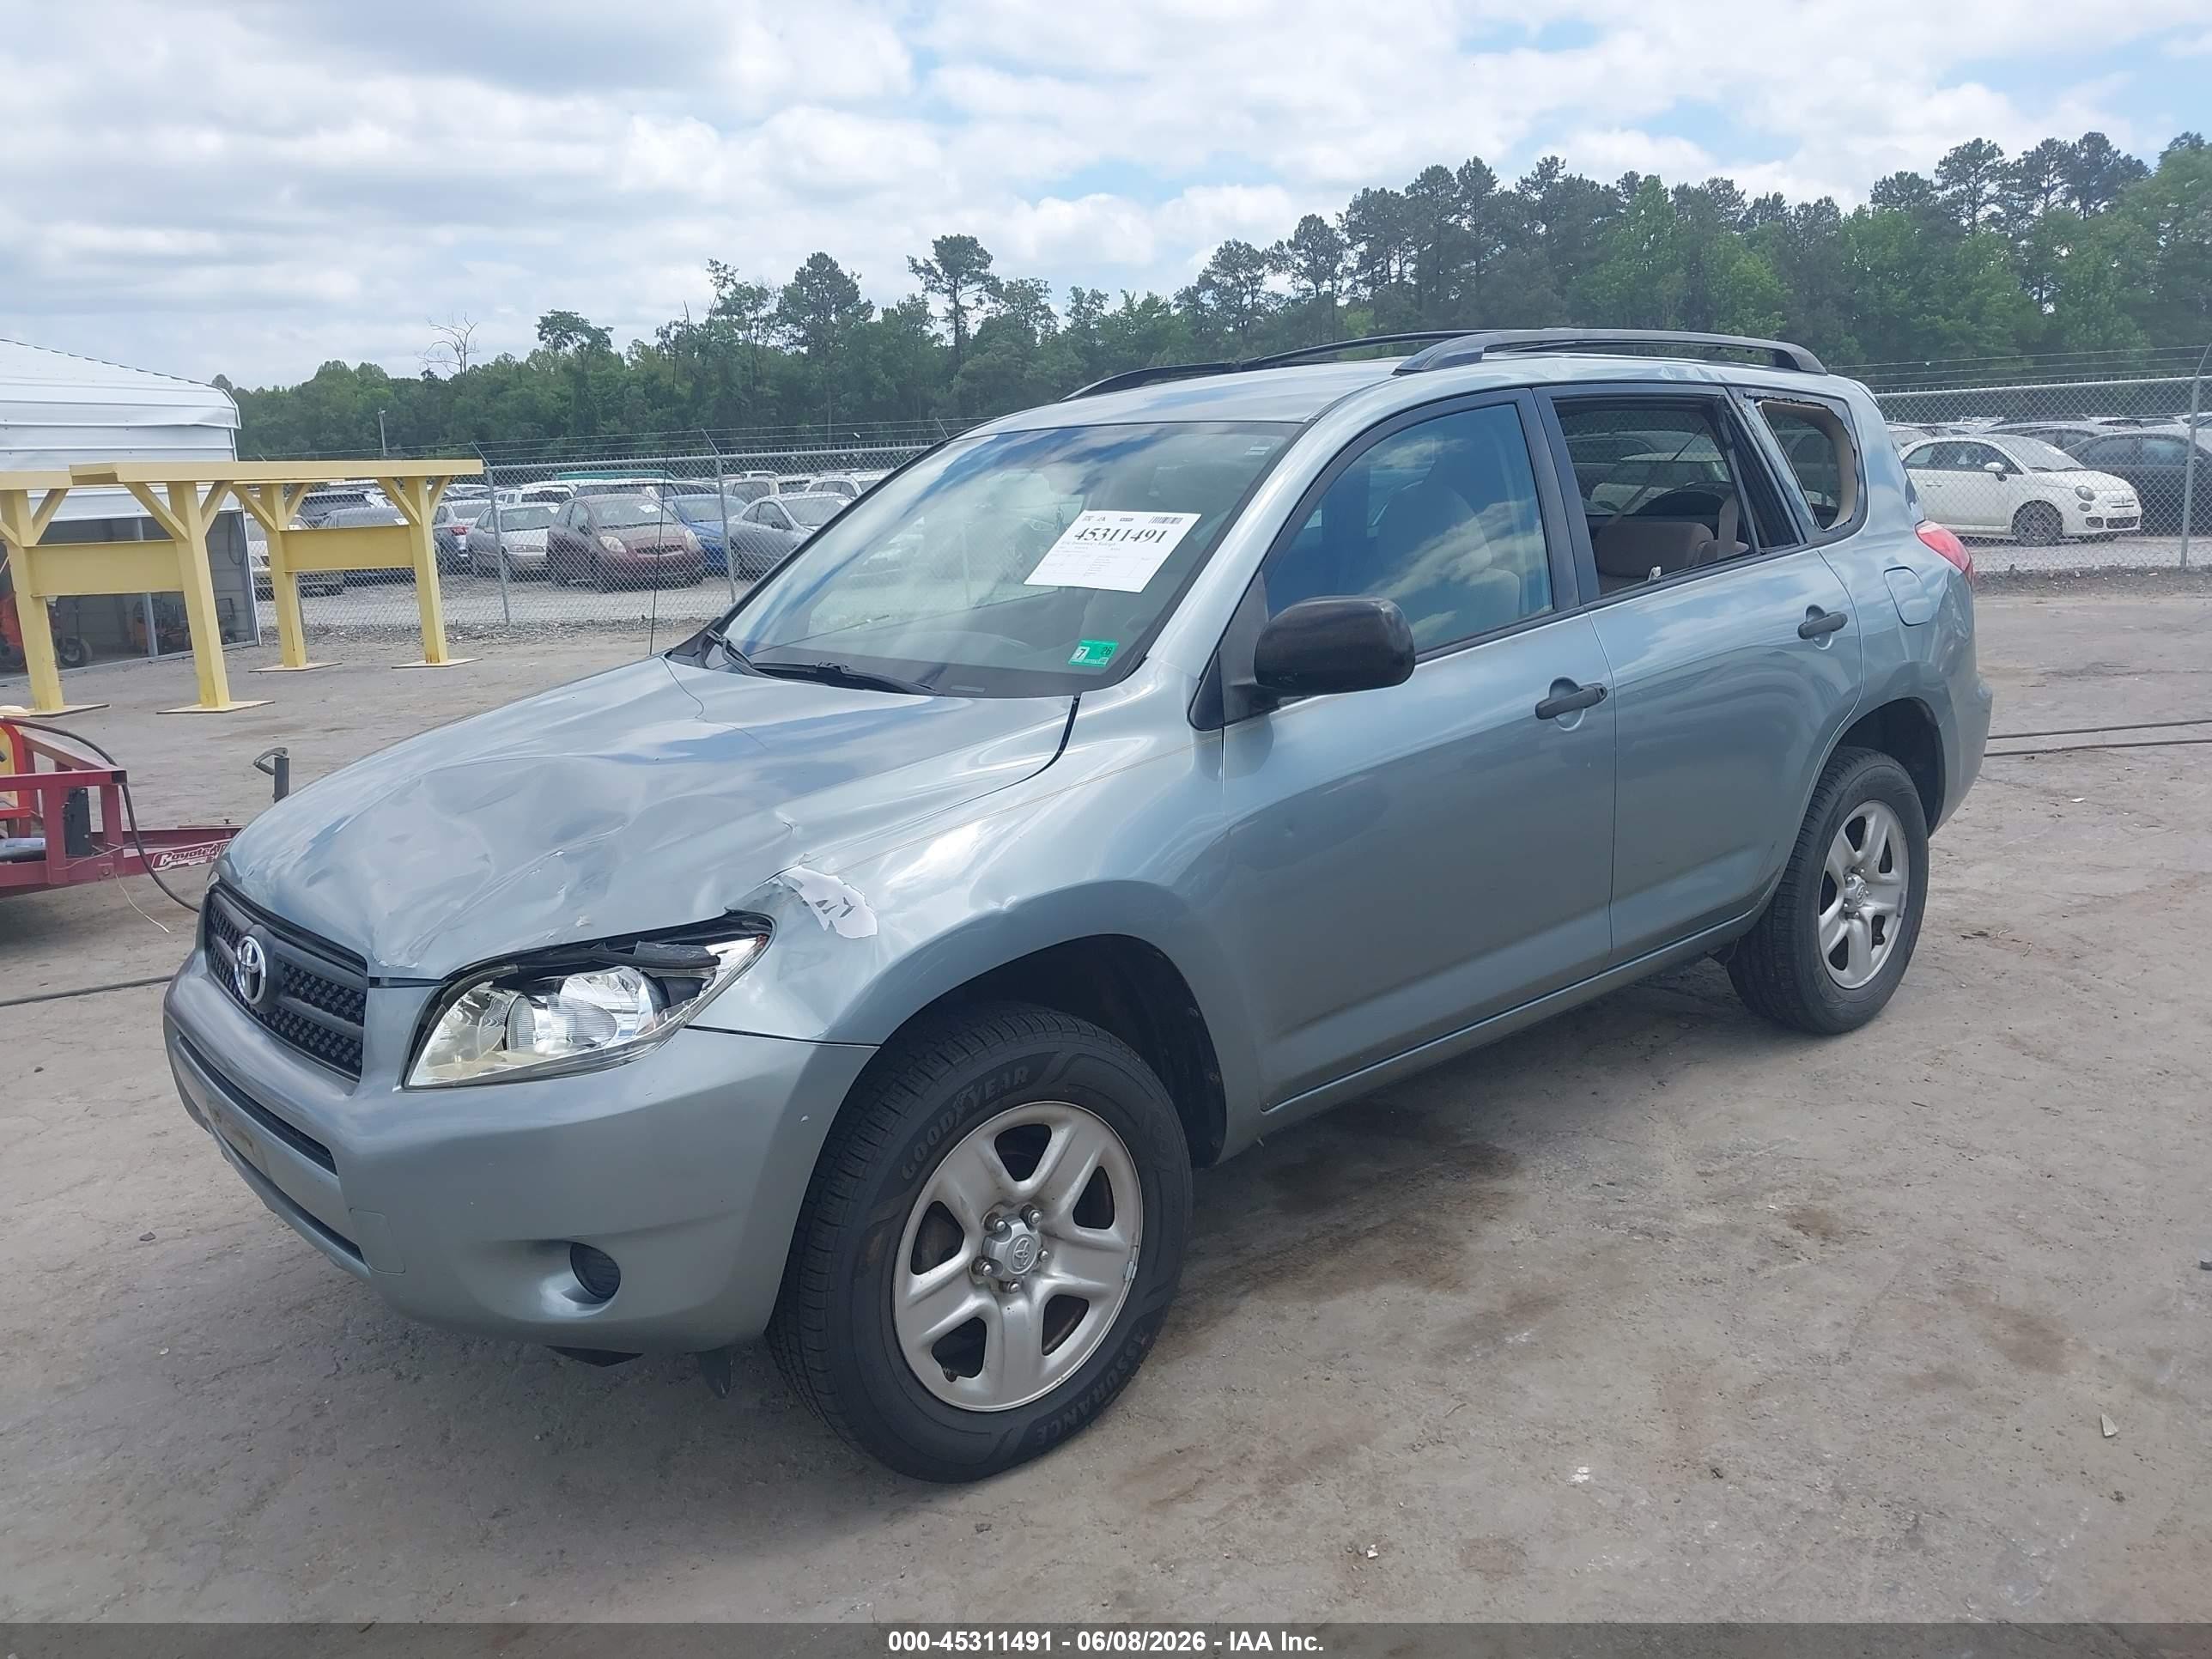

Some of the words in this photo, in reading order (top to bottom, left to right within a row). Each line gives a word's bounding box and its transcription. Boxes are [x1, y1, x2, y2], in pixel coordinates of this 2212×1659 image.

[1074, 527, 1168, 544] 45311491
[1077, 648, 1087, 659] 7
[1101, 646, 1113, 655] 26
[901, 1065, 1030, 1181] GOODYEAR
[1036, 1332, 1151, 1446] ASSURANCE
